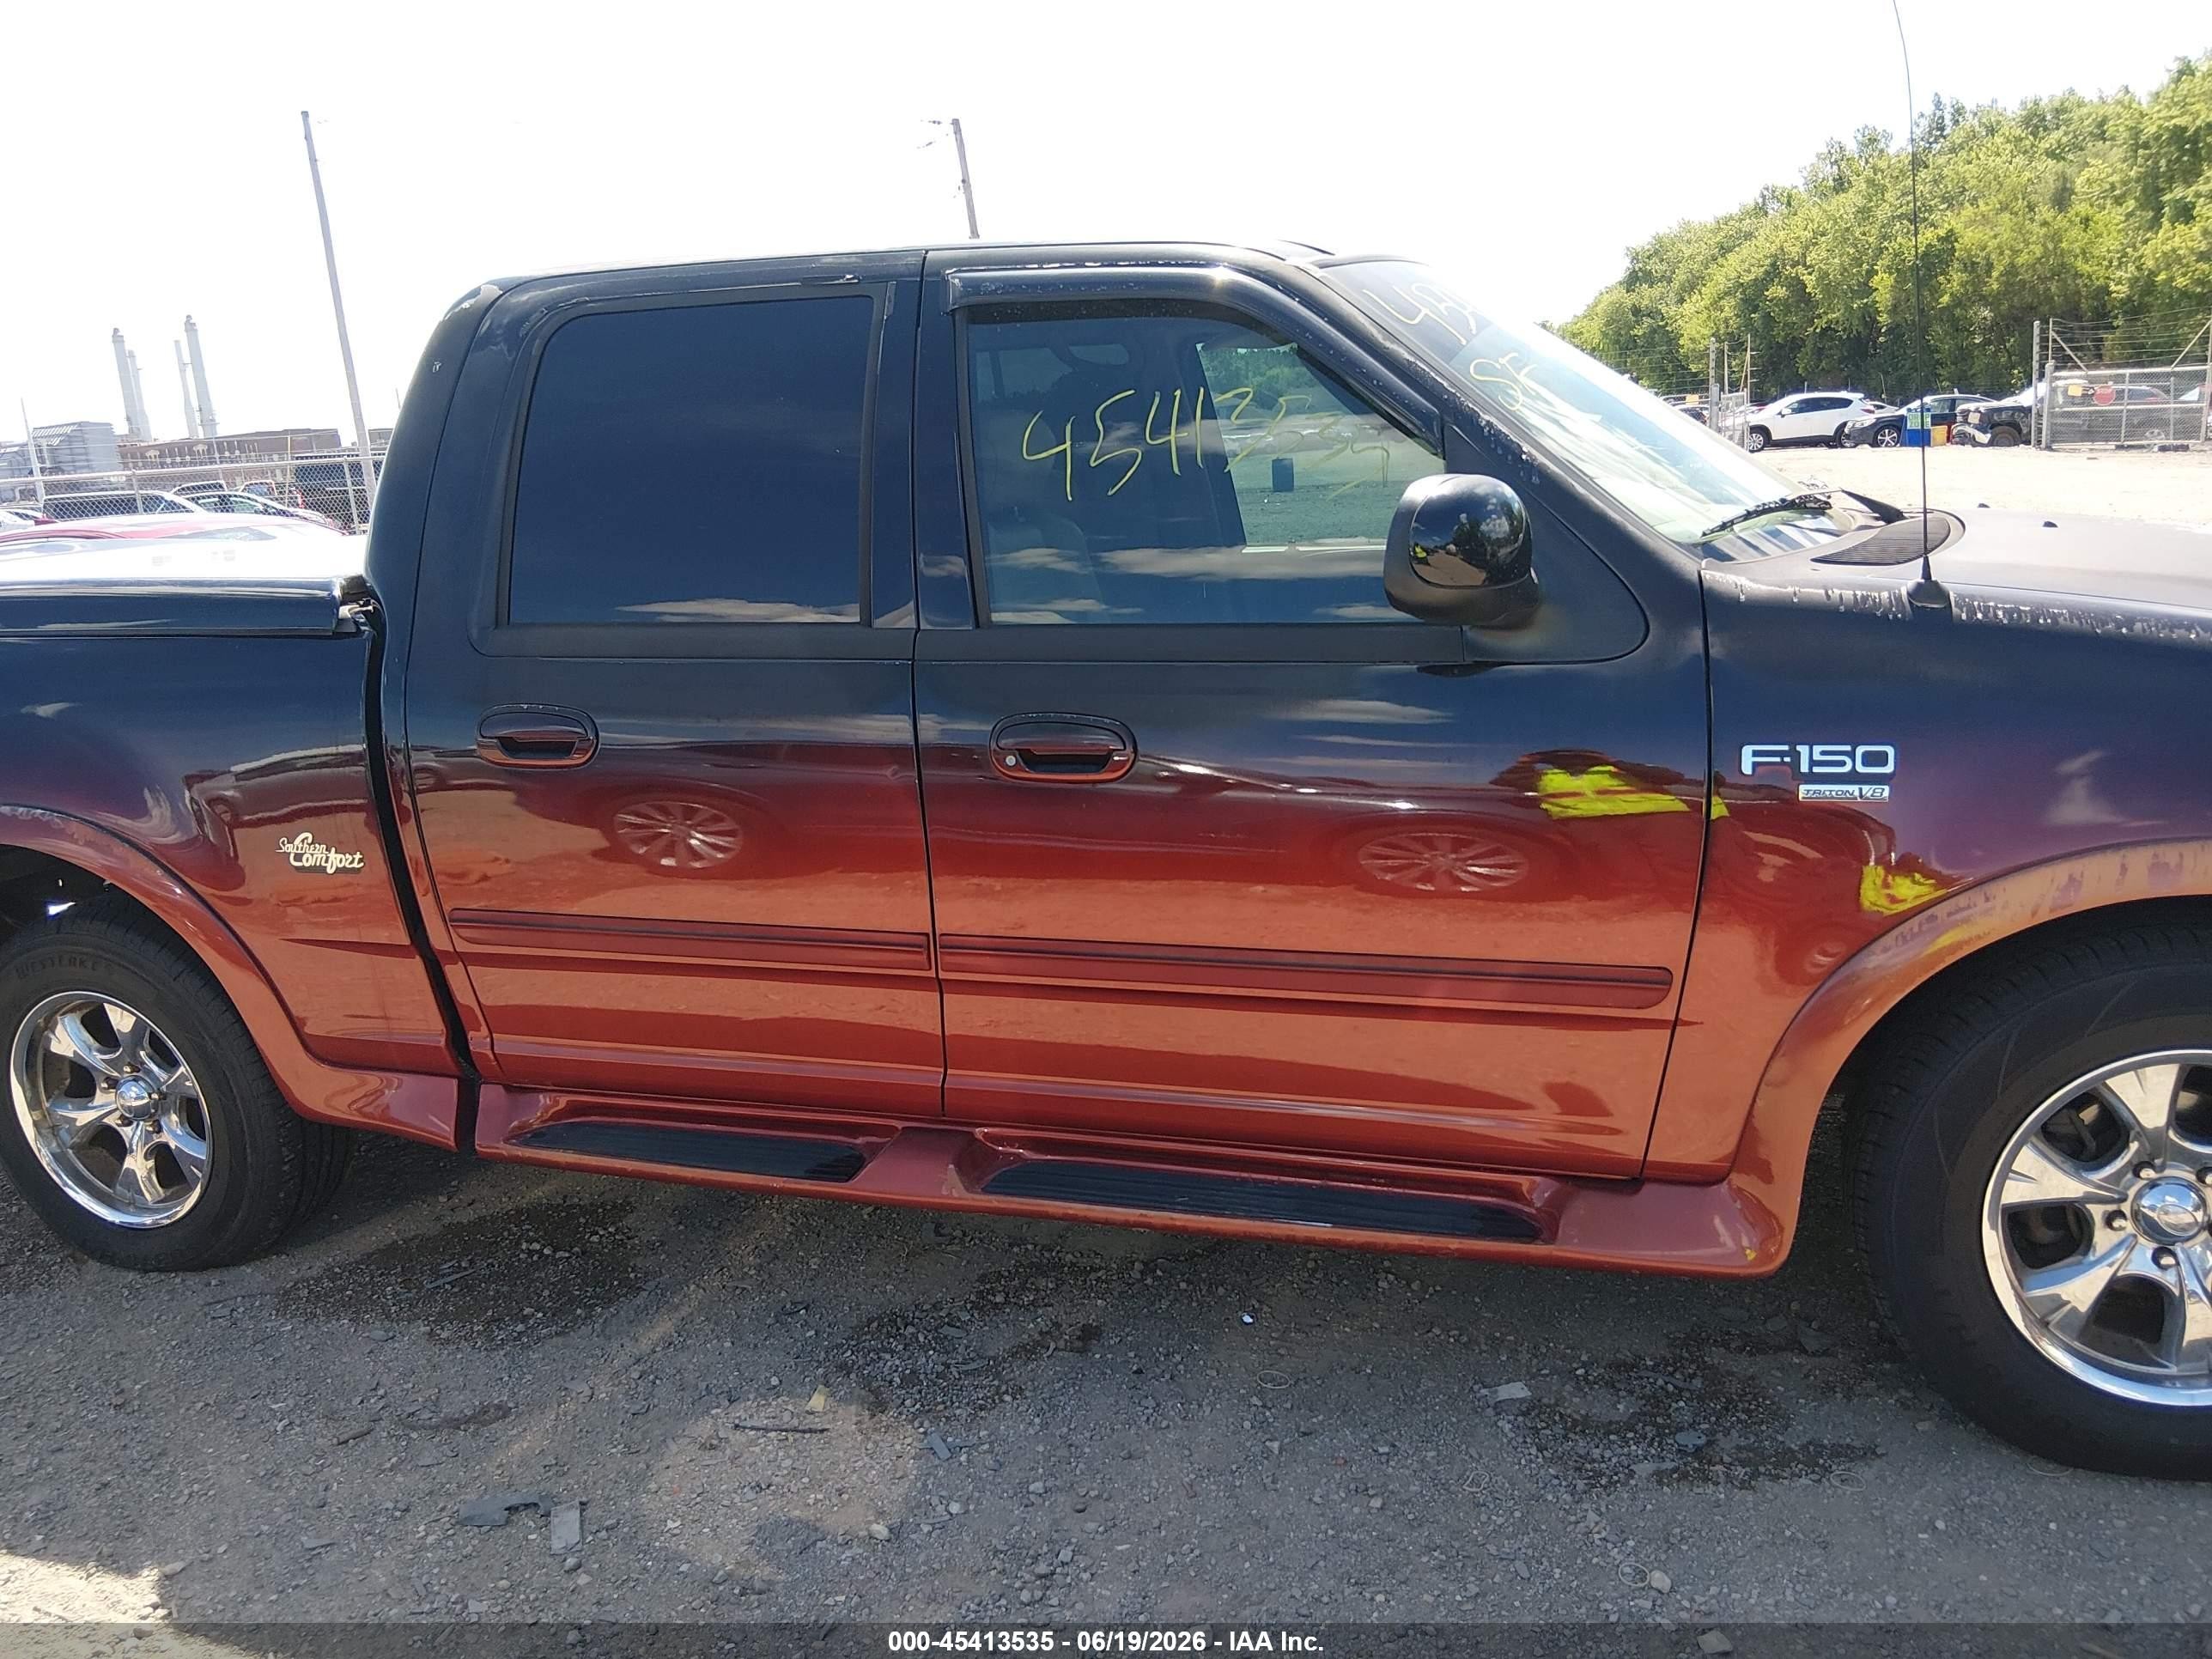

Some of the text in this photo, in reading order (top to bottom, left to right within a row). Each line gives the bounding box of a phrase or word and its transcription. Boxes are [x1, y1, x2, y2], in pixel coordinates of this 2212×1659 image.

[1741, 744, 1895, 775] F-150
[275, 837, 329, 854] Southern
[289, 832, 364, 874] Comfort
